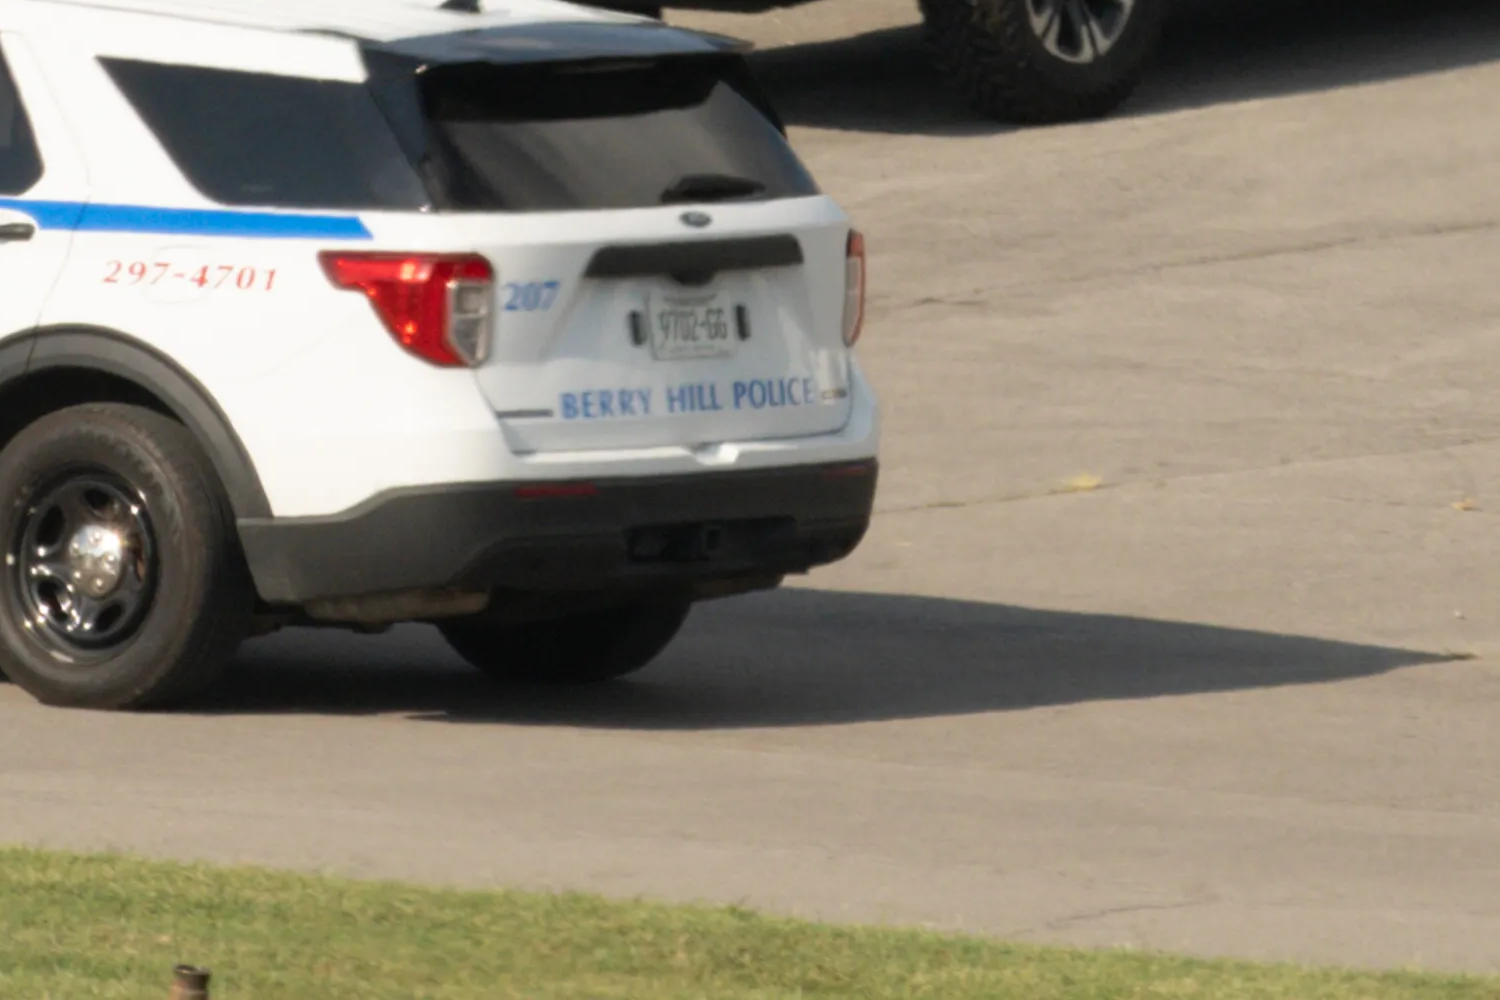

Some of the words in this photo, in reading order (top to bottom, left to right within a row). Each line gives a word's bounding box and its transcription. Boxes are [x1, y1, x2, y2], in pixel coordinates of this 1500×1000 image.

[102, 259, 278, 293] 297-4701
[504, 280, 561, 312] 207
[560, 388, 652, 419] BERRY
[667, 383, 722, 413] HILL
[734, 377, 814, 409] POLICE
